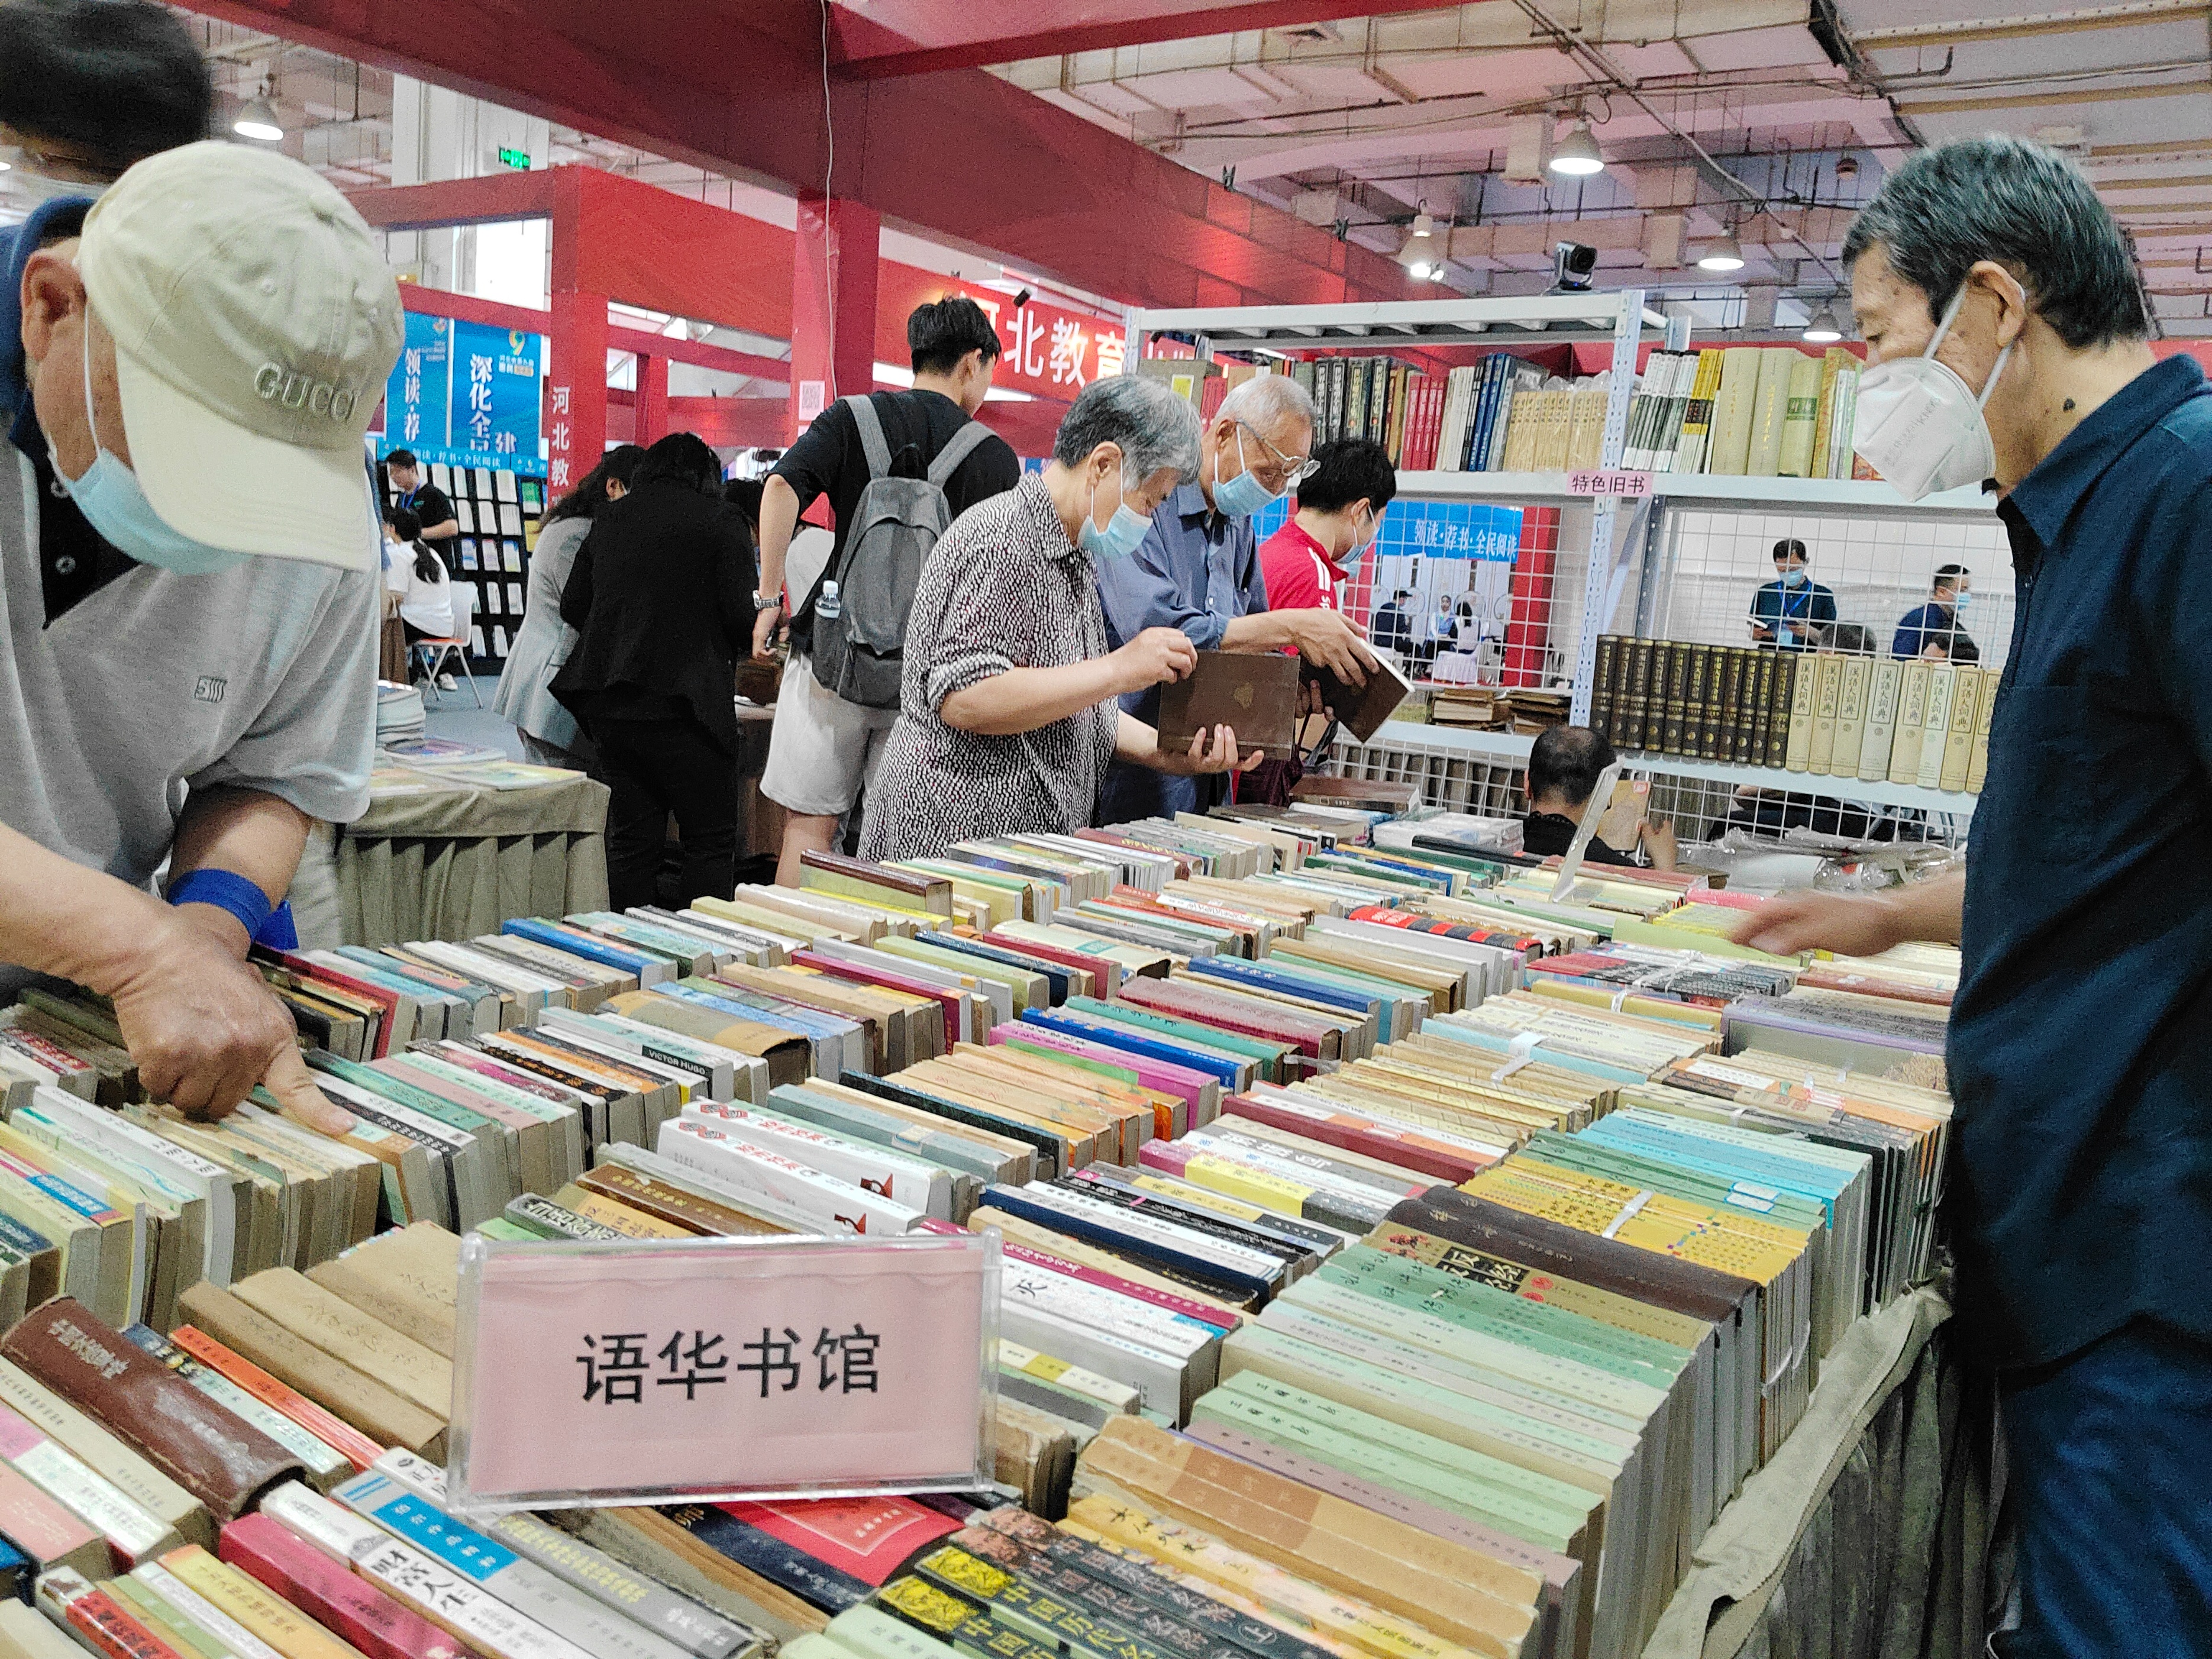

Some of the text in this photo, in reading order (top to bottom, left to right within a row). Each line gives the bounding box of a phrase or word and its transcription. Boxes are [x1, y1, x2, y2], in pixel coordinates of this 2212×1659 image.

[254, 362, 358, 421] GUCCI
[1571, 474, 1645, 494] 特色旧书
[648, 1048, 706, 1075] VICTOR HUGO
[576, 1323, 881, 1405] 语华书馆
